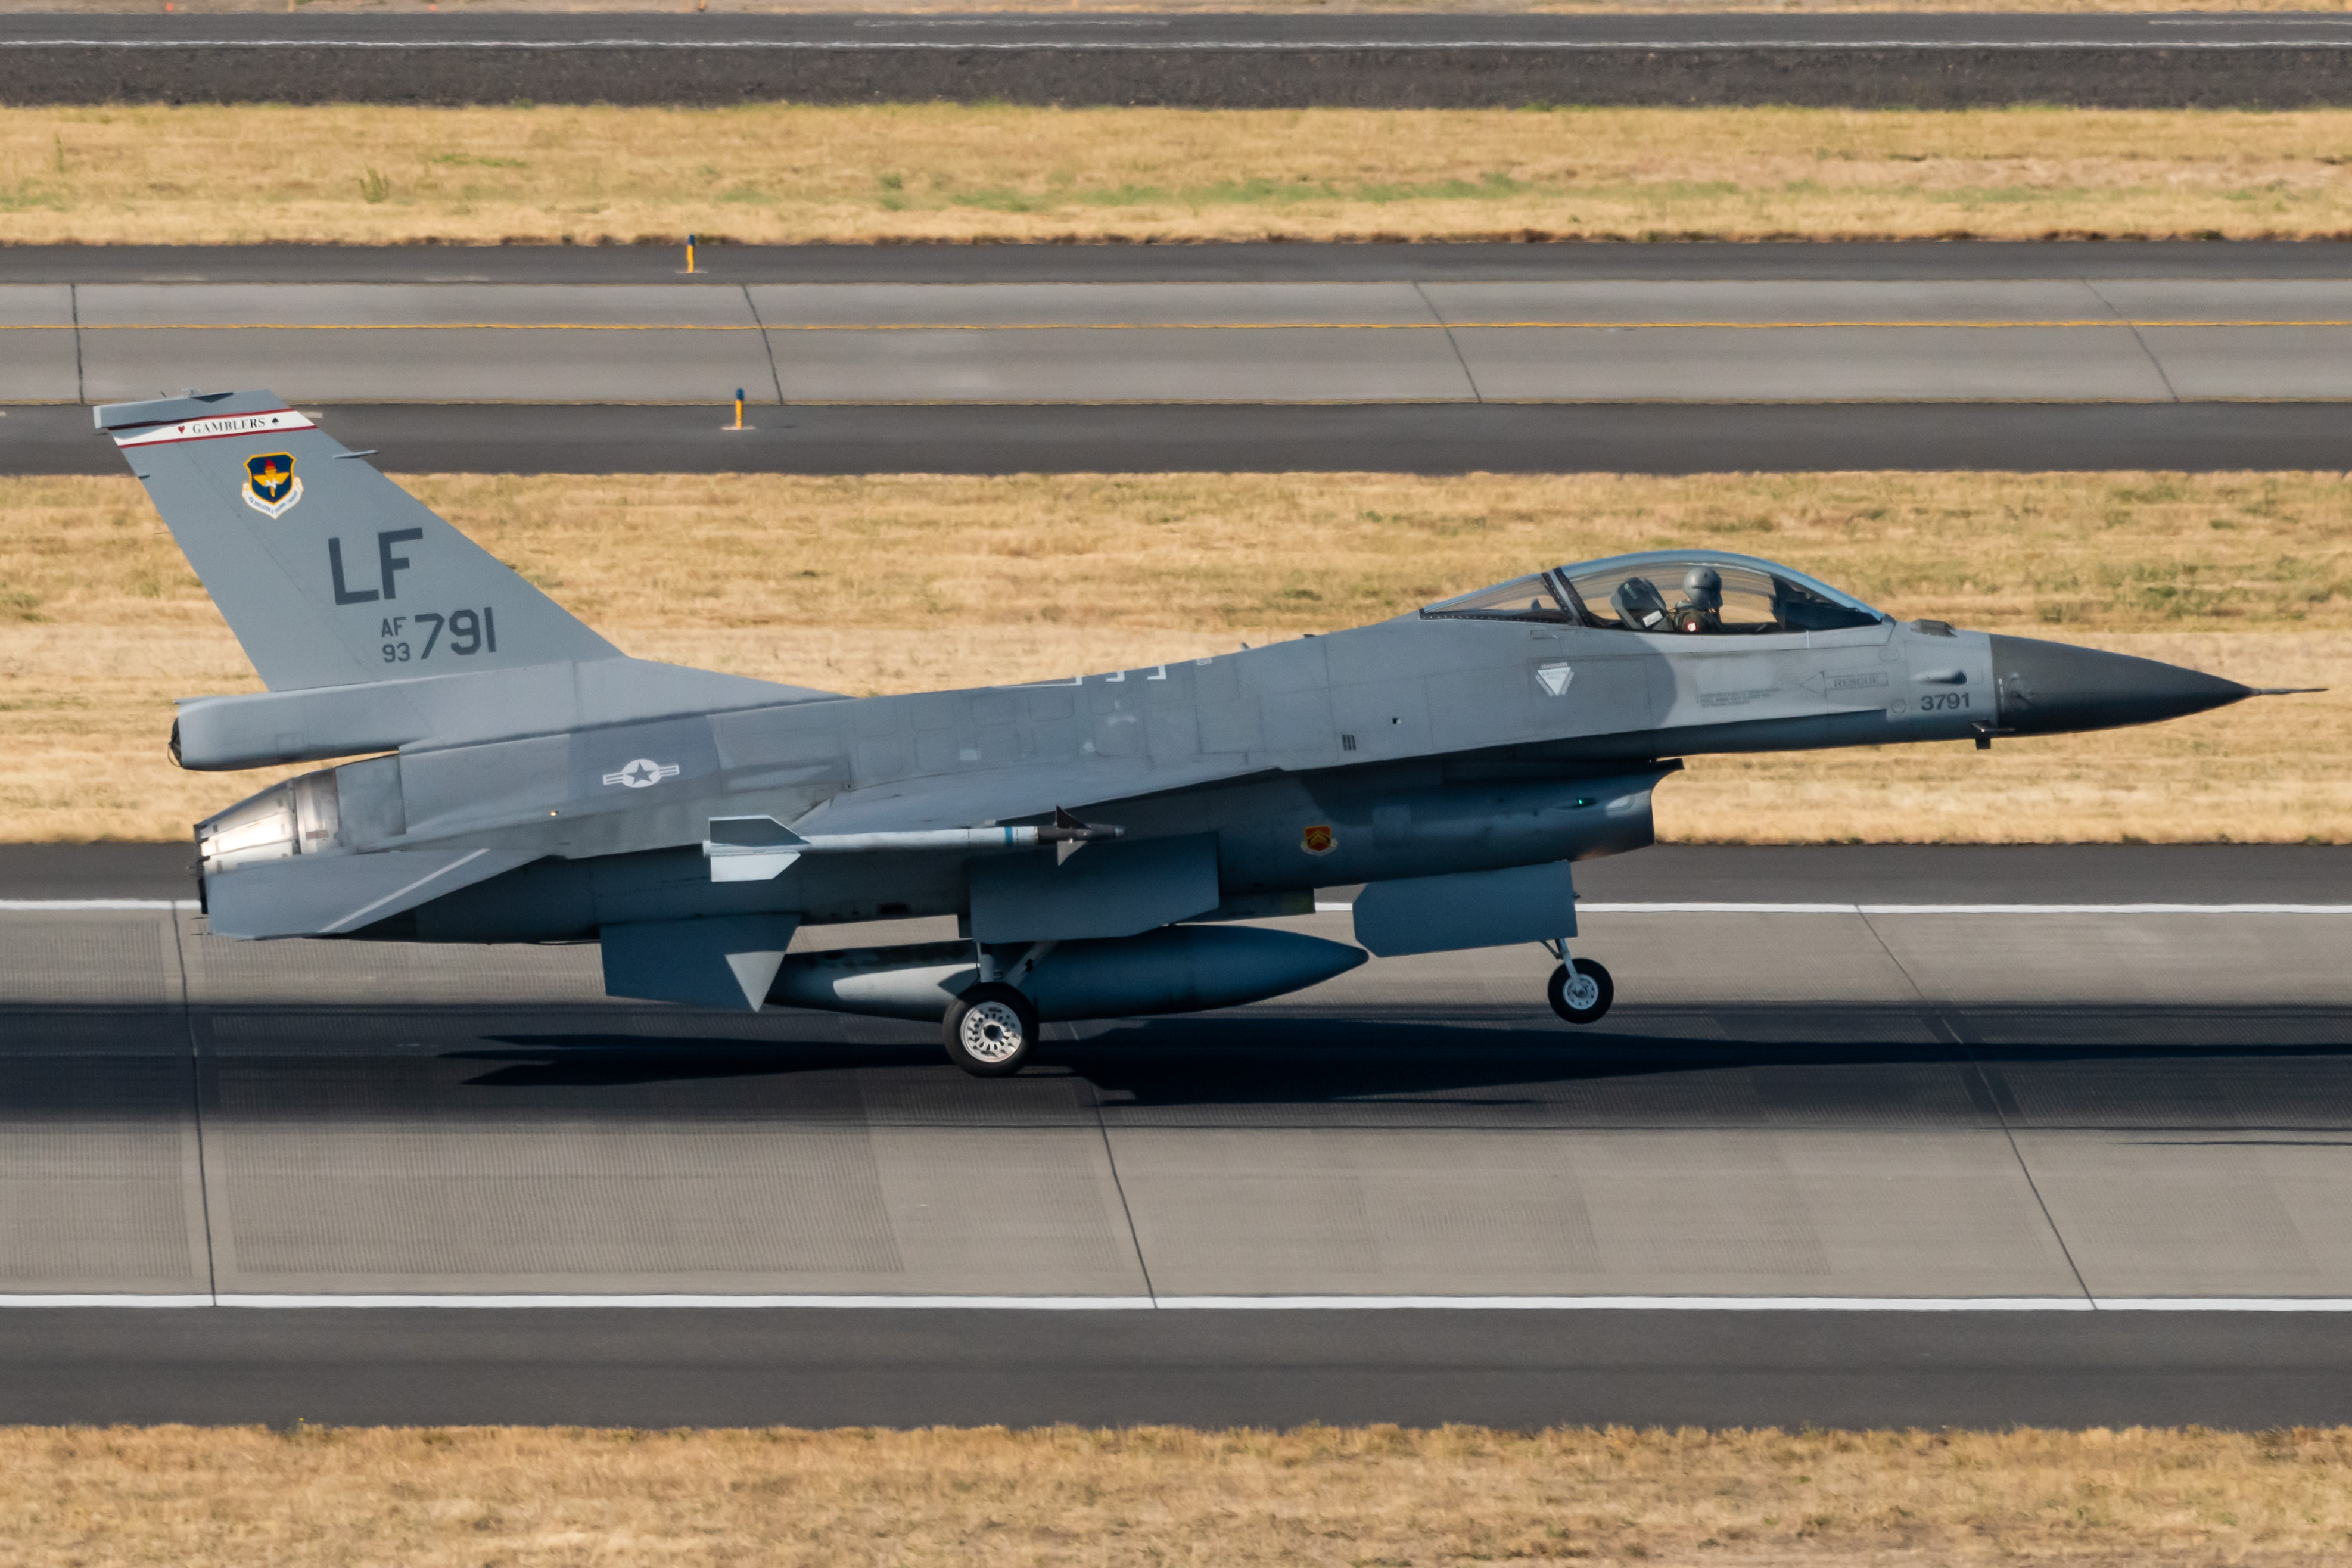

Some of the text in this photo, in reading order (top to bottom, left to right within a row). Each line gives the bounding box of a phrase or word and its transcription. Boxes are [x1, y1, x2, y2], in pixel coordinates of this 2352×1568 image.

[192, 417, 266, 434] GAMBLERS
[328, 527, 424, 606] LF
[381, 616, 407, 638] AF
[415, 606, 497, 660] 791
[381, 642, 411, 663] 93
[1921, 692, 1970, 711] 3791
